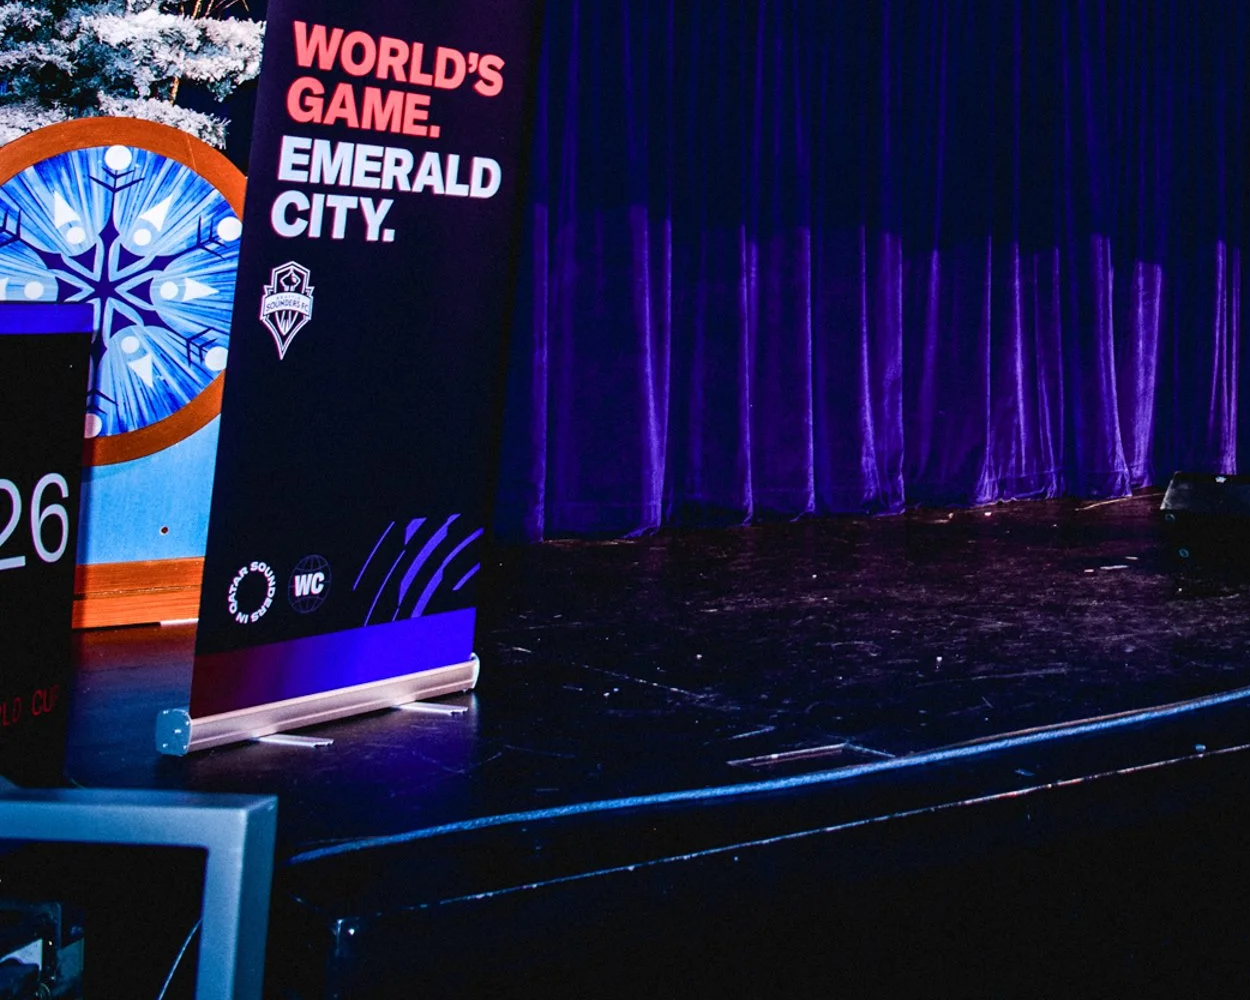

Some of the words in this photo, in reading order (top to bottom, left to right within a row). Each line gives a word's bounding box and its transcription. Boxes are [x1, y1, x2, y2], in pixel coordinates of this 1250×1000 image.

[293, 20, 506, 97] WORLD'S
[287, 76, 441, 138] GAME.
[278, 135, 502, 199] EMERALD
[270, 190, 396, 242] CITY.
[228, 567, 249, 614] QATAR
[250, 561, 276, 622] SOUNDERS
[294, 572, 325, 597] WC
[235, 612, 249, 624] IN
